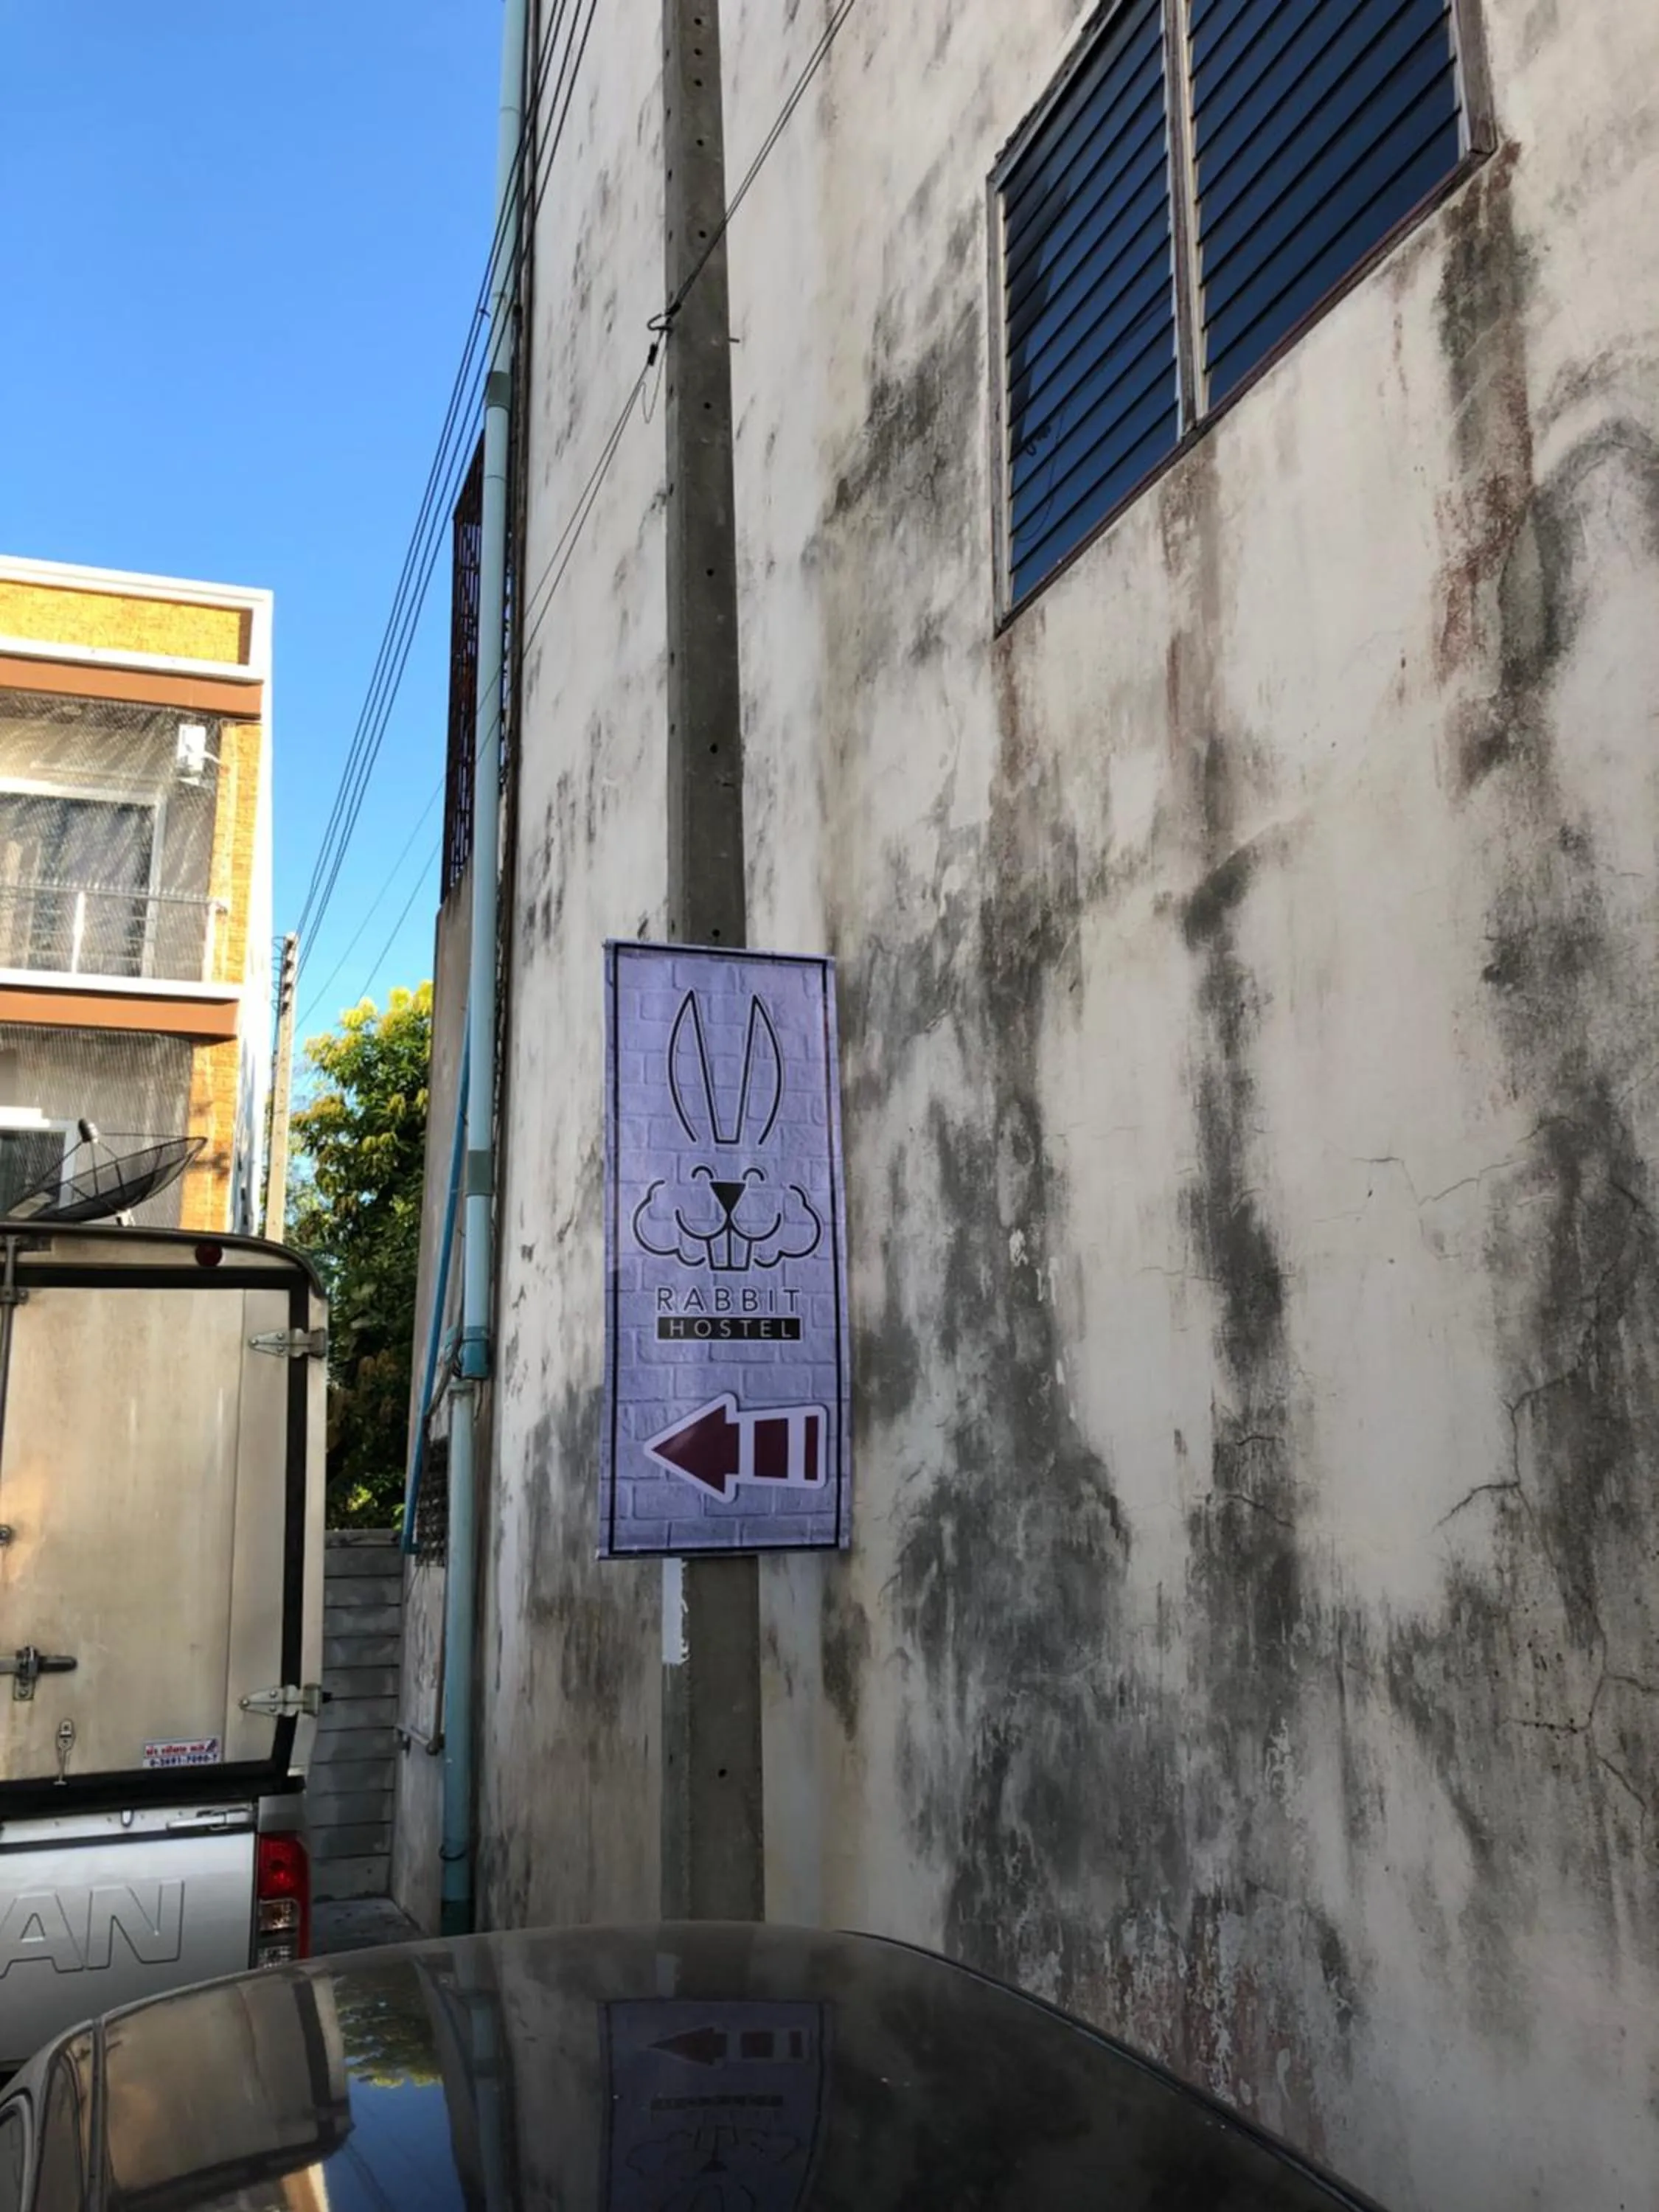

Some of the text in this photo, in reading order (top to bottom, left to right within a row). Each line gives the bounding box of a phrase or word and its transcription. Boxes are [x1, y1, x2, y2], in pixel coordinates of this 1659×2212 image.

[658, 1287, 800, 1312] RABBIT
[669, 1320, 792, 1338] HOSTEL
[0, 1880, 184, 1978] AN
